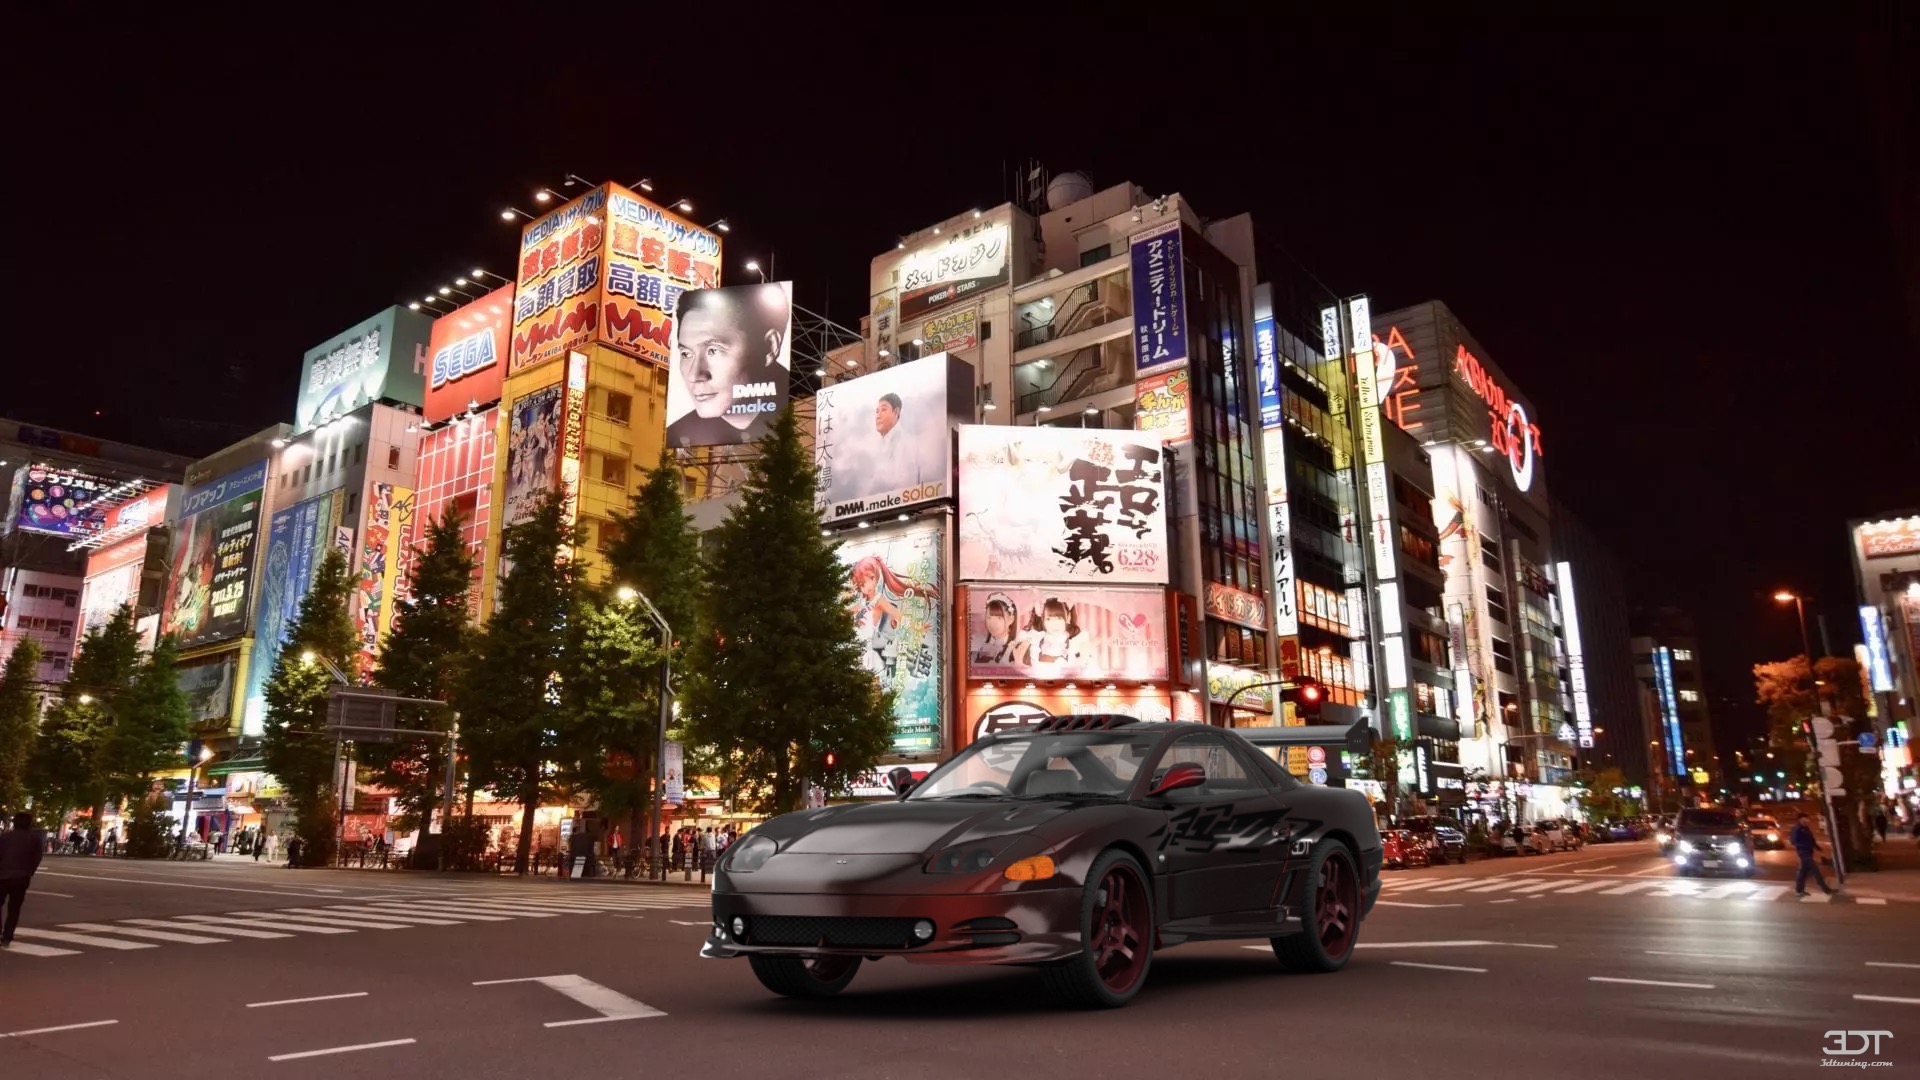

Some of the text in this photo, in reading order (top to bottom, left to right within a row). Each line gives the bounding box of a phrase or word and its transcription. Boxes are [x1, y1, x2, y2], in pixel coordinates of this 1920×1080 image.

[612, 195, 720, 256] MEDIAリサイクル
[517, 255, 598, 325] 高額買取
[929, 280, 976, 304] POKER STARS
[1147, 239, 1169, 359] アメニティードリーム
[514, 302, 598, 367] Mulan
[432, 329, 496, 386] SEGA
[732, 382, 777, 398] DMM
[1140, 391, 1186, 411] まんが
[1360, 377, 1371, 403] Yellow
[726, 399, 777, 414] .make
[184, 481, 227, 513] ソフマップ
[835, 481, 943, 517] DMM.make solar
[1117, 550, 1156, 567] 6.28
[1274, 506, 1294, 617] 喫茶室ルノアール
[915, 725, 931, 733] Model
[1291, 839, 1313, 855] 3DT
